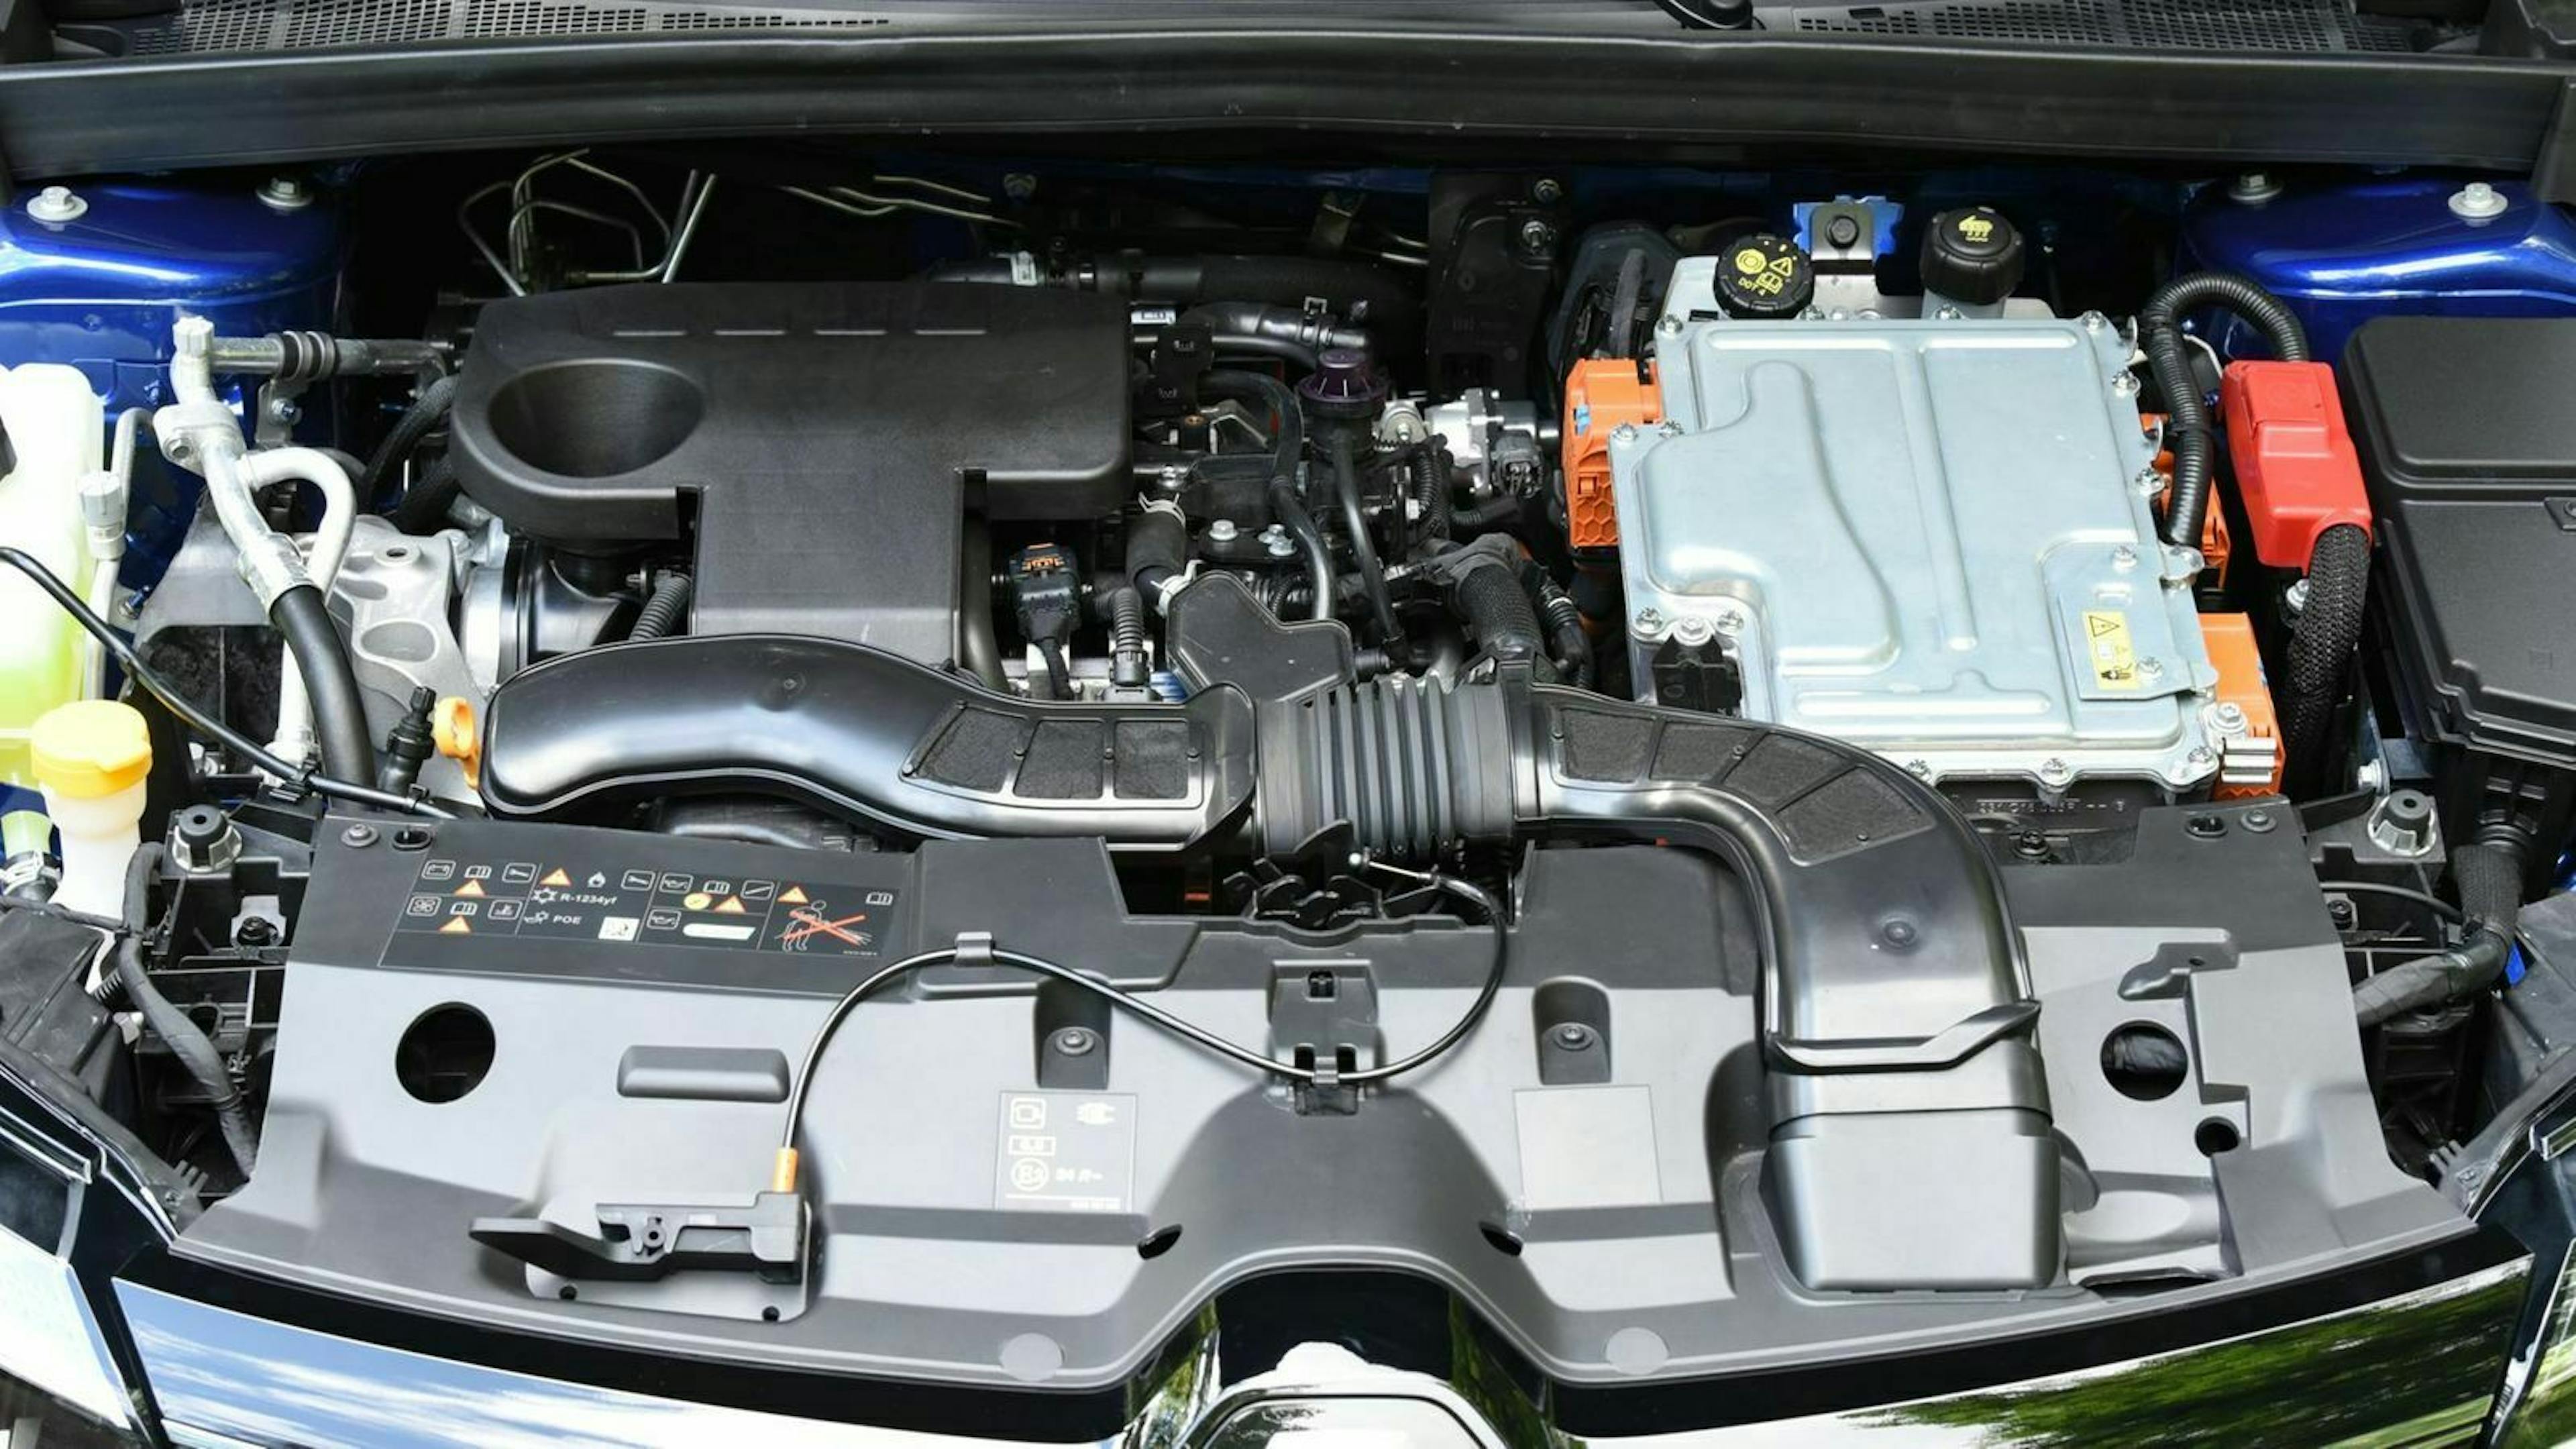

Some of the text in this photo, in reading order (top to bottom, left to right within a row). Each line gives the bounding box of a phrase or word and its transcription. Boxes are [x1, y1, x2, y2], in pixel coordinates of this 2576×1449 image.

[1739, 276, 1758, 291] DOT
[560, 894, 617, 906] R-1234yf
[553, 914, 582, 924] POE
